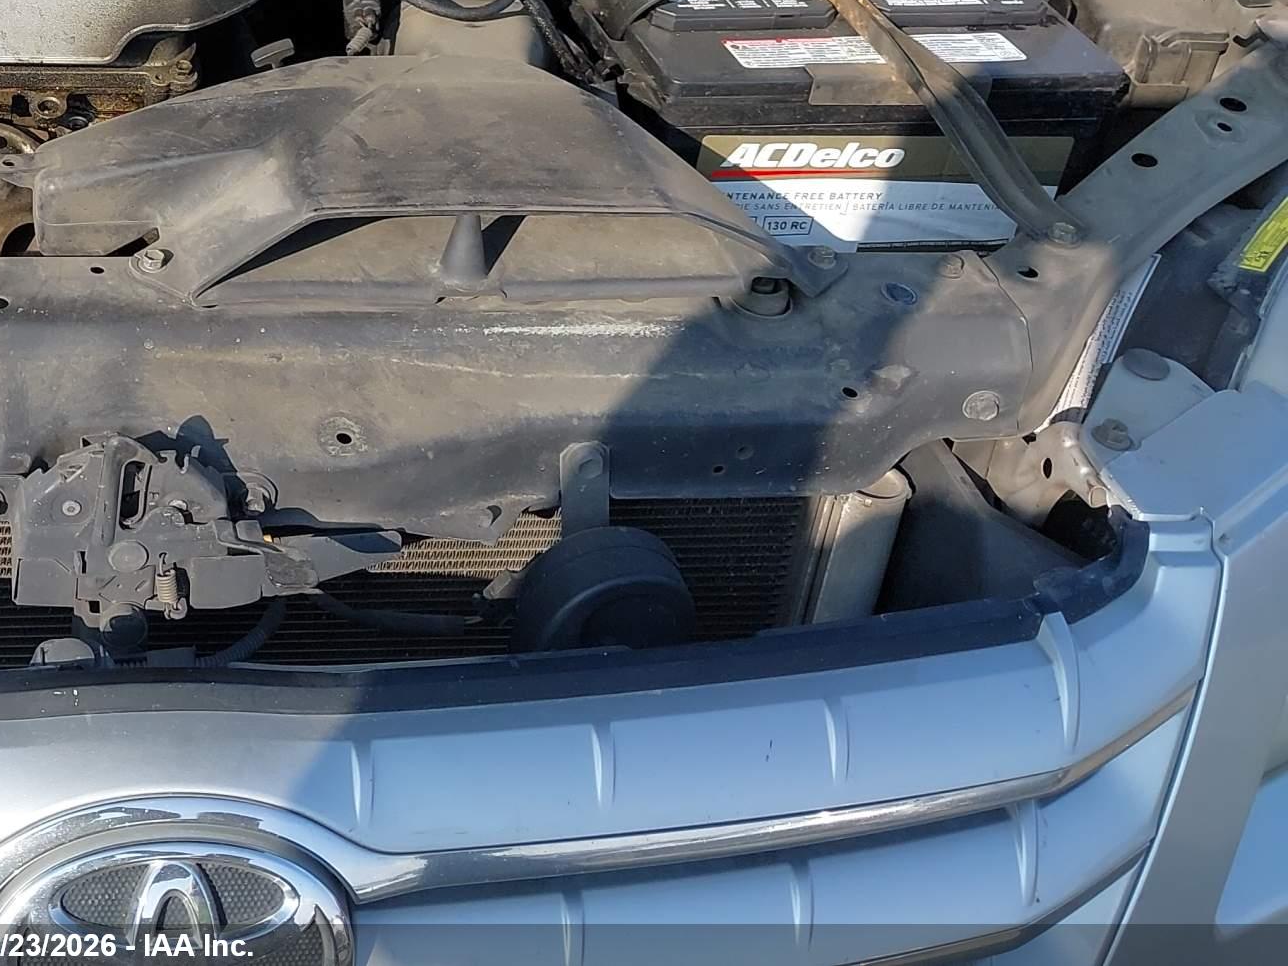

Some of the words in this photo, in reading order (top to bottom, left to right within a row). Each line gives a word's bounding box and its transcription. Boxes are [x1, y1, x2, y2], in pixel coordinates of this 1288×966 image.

[719, 142, 906, 169] ACDelco
[726, 192, 789, 201] NTENANCE
[793, 192, 825, 201] FREE
[828, 192, 884, 201] BATTERY
[753, 202, 781, 211] SANS
[898, 202, 928, 211] LIBRE
[930, 202, 945, 211] DE
[948, 202, 999, 211] MANTENI
[766, 221, 787, 231] 130
[790, 220, 809, 231] RC
